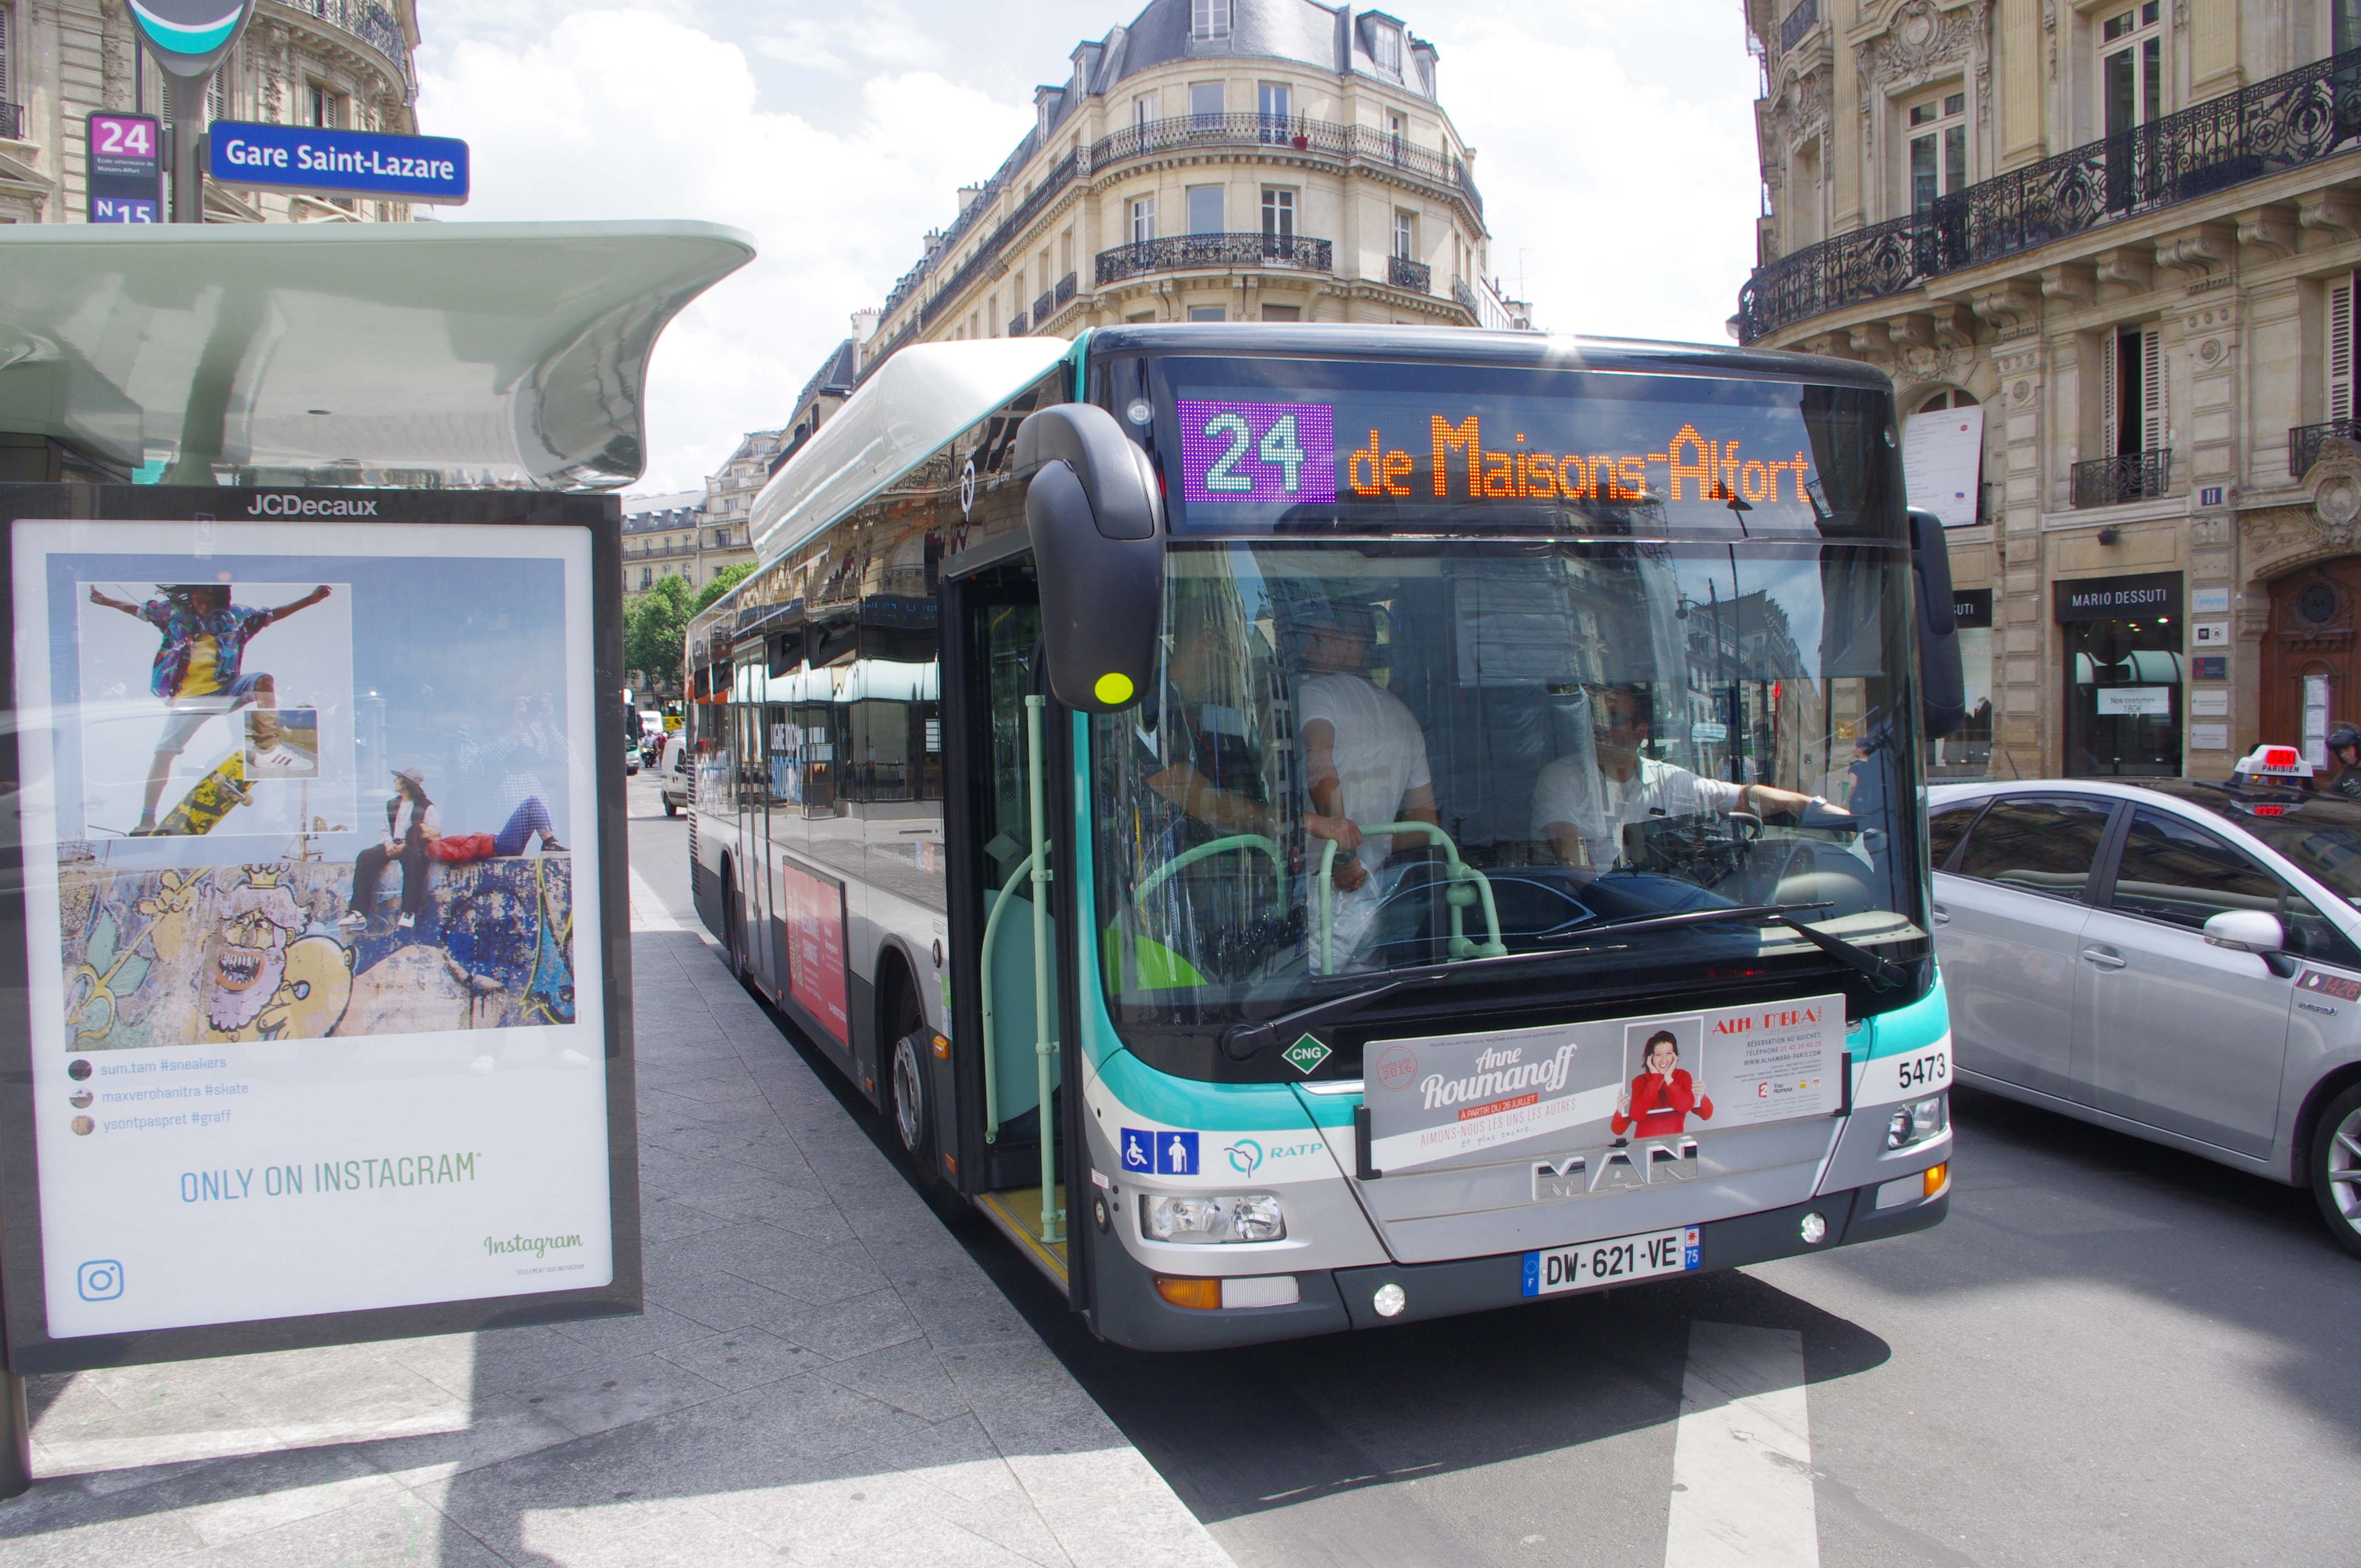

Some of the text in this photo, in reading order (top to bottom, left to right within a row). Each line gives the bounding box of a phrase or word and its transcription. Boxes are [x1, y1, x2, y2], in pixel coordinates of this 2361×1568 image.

[101, 121, 149, 154] 24
[226, 139, 455, 180] Gare Saint-Lazare
[97, 166, 140, 174] Maisons-Alfort
[1205, 413, 1811, 503] 24 de Maisons-Alfort
[247, 494, 378, 516] JCDecaux
[2071, 589, 2166, 607] MARIO DESSUTI
[2123, 705, 2142, 713] 180€
[2271, 750, 2295, 765] TAXI
[2262, 764, 2299, 773] PARISIEN
[2322, 977, 2361, 998] 1426
[1712, 1008, 1816, 1038] ALHAMBRA
[1747, 1037, 1785, 1047] RÉSERVATION
[1796, 1032, 1822, 1041] GUICHET,
[1292, 1047, 1321, 1060] CNG
[1475, 1047, 1522, 1074] Anne
[1743, 1050, 1821, 1066] WWW.ALHAMBRA-PARIS.COM
[1745, 1046, 1779, 1057] TÉLÉPHONE
[100, 1057, 227, 1075] sum.tam #sneakers
[1380, 1057, 1411, 1071] VERSION
[1383, 1063, 1412, 1080] 2016
[1899, 1052, 1945, 1088] 5473
[1420, 1043, 1577, 1110] Roumanoff
[102, 1083, 248, 1103] maxverohanitra #skate
[1760, 1085, 1768, 1096] 2
[1460, 1095, 1536, 1119] À PARTIR DU 26 JUILLET
[104, 1109, 231, 1134] ysontpaspret #graff
[1420, 1098, 1576, 1147] AIMONS-NOUS LES UNS LES AUTRES
[1461, 1139, 1471, 1147] Et
[1477, 1132, 1495, 1147] plus
[1270, 1142, 1323, 1159] RATP
[1531, 1139, 1698, 1201] MAN
[181, 1168, 254, 1203] ONLY
[264, 1164, 303, 1196] ON
[483, 1233, 584, 1259] Instagram
[1528, 1278, 1534, 1287] F
[1686, 1249, 1698, 1264] 75
